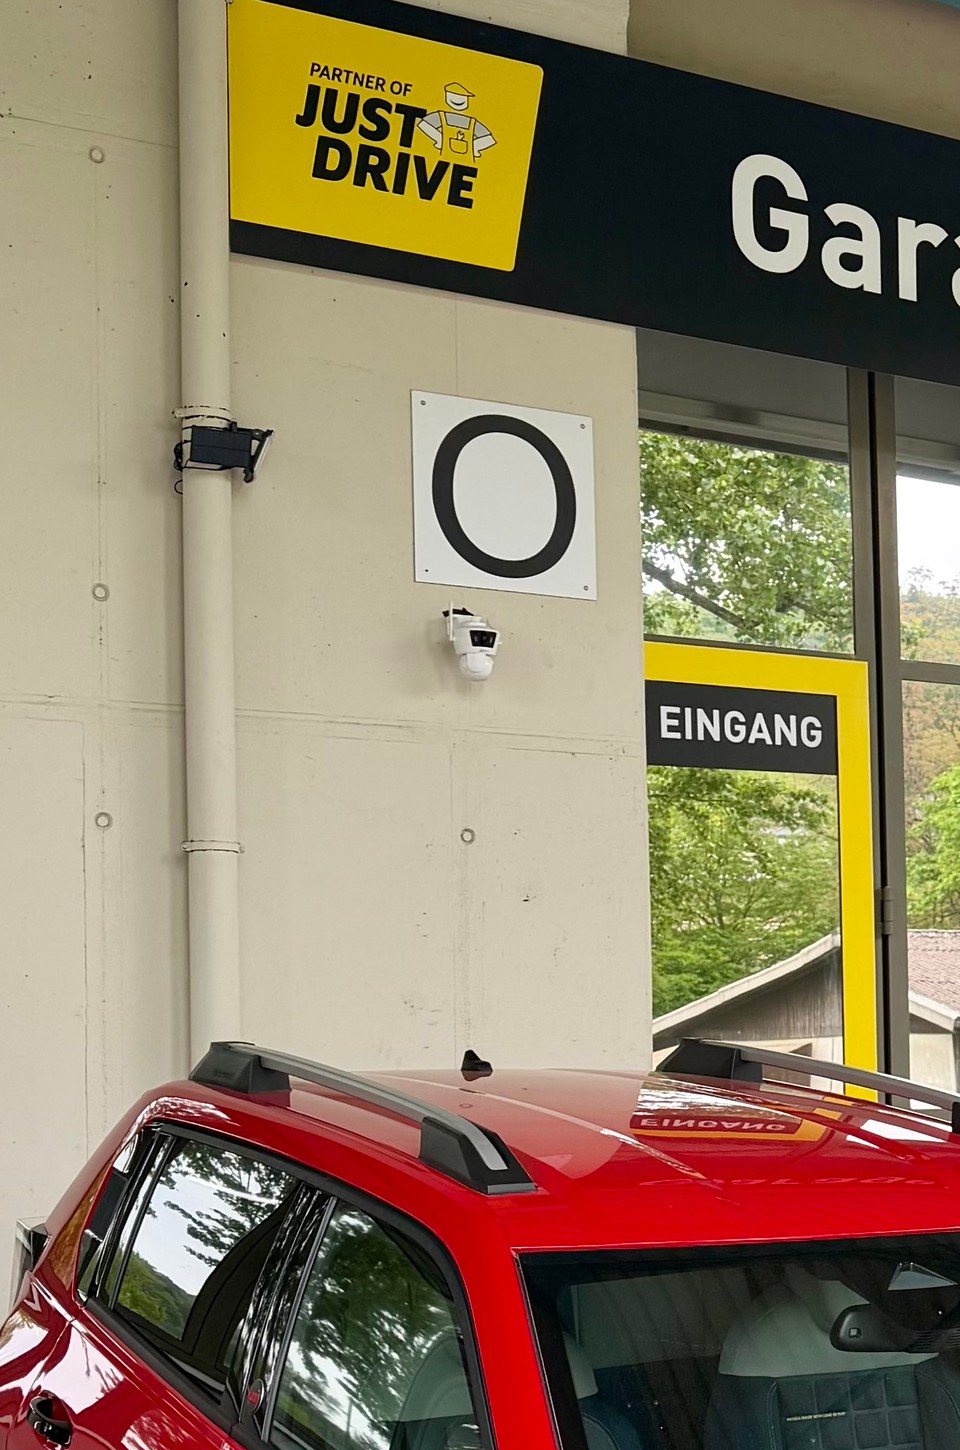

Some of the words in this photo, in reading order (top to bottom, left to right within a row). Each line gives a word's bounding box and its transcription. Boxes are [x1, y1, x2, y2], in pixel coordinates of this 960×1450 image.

[309, 62, 386, 92] PARTNER
[389, 80, 413, 97] OF
[295, 83, 428, 149] JUST
[311, 135, 479, 209] DRIVE
[659, 704, 823, 749] EINGANG
